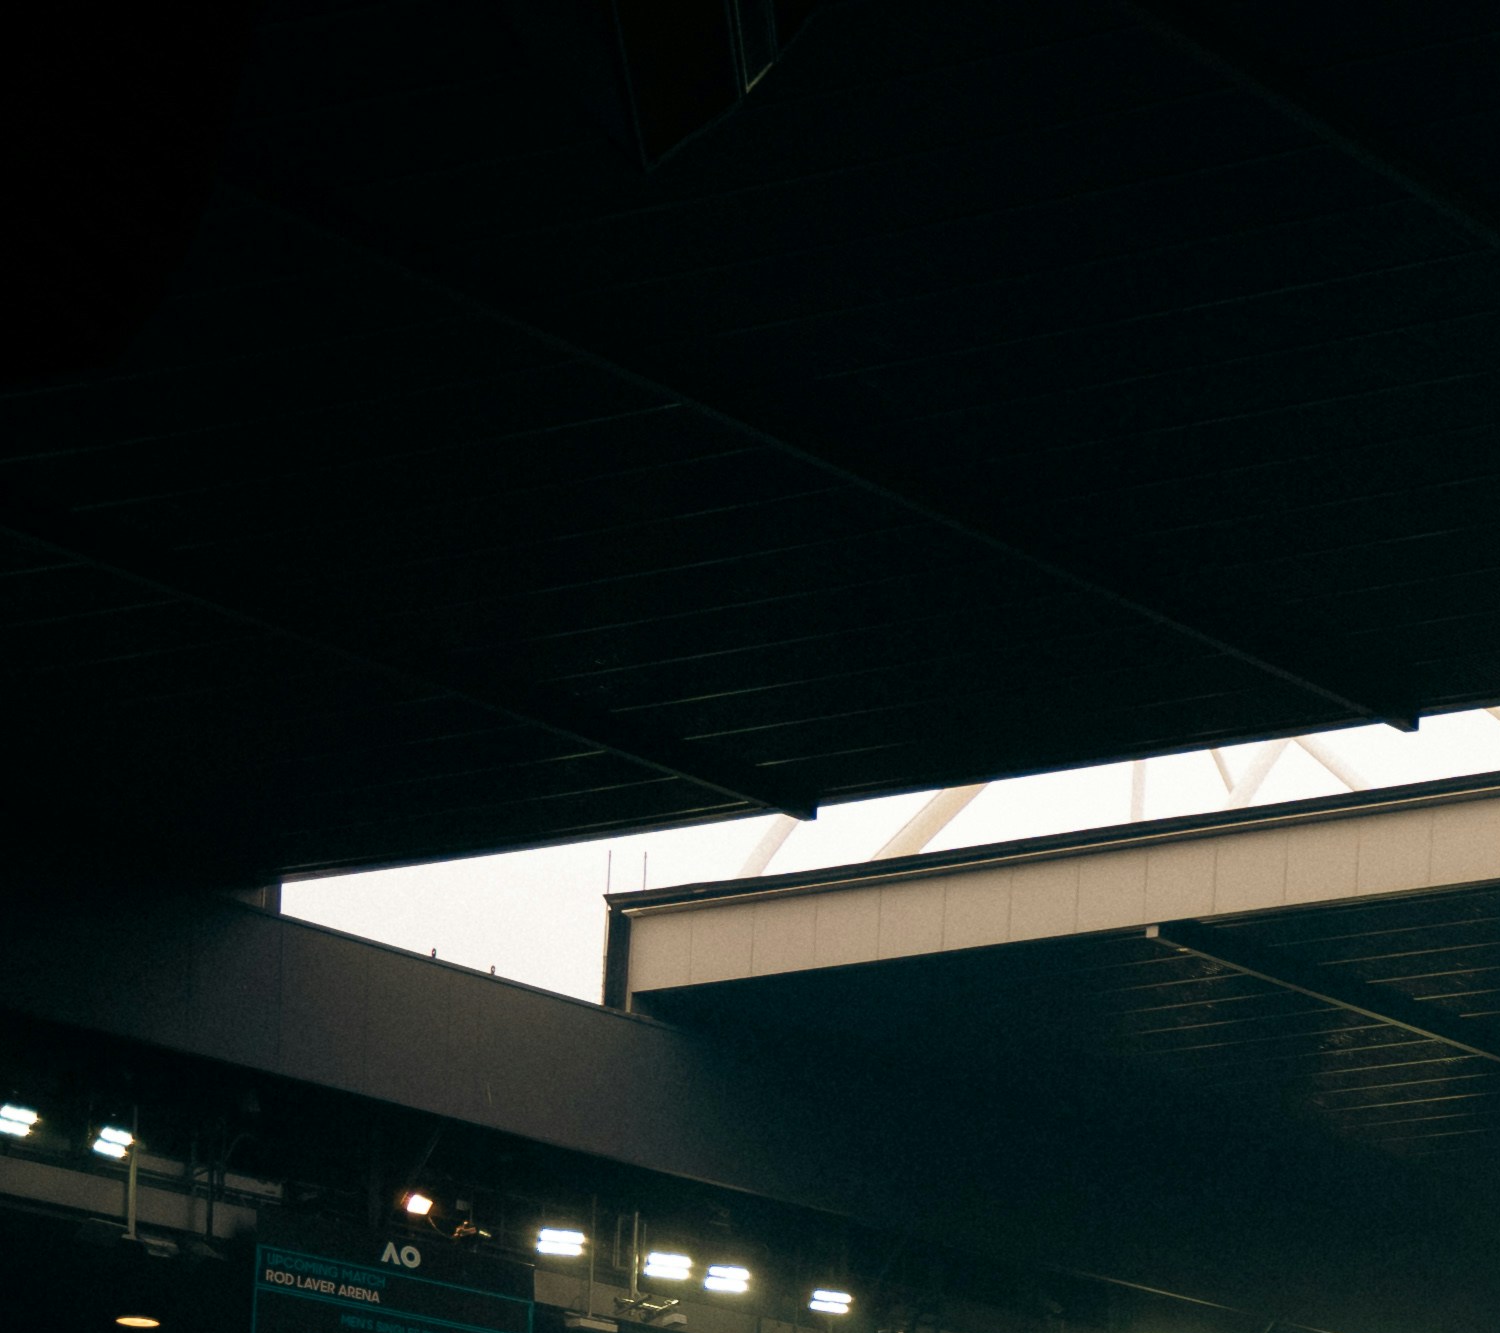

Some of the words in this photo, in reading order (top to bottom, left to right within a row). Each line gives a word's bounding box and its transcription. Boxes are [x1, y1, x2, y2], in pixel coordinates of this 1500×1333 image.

[265, 1269, 294, 1287] ROD
[297, 1276, 336, 1297] LAVER
[338, 1285, 380, 1304] ARENA
[267, 1252, 338, 1279] UPCOMING
[342, 1267, 386, 1288] MATCH
